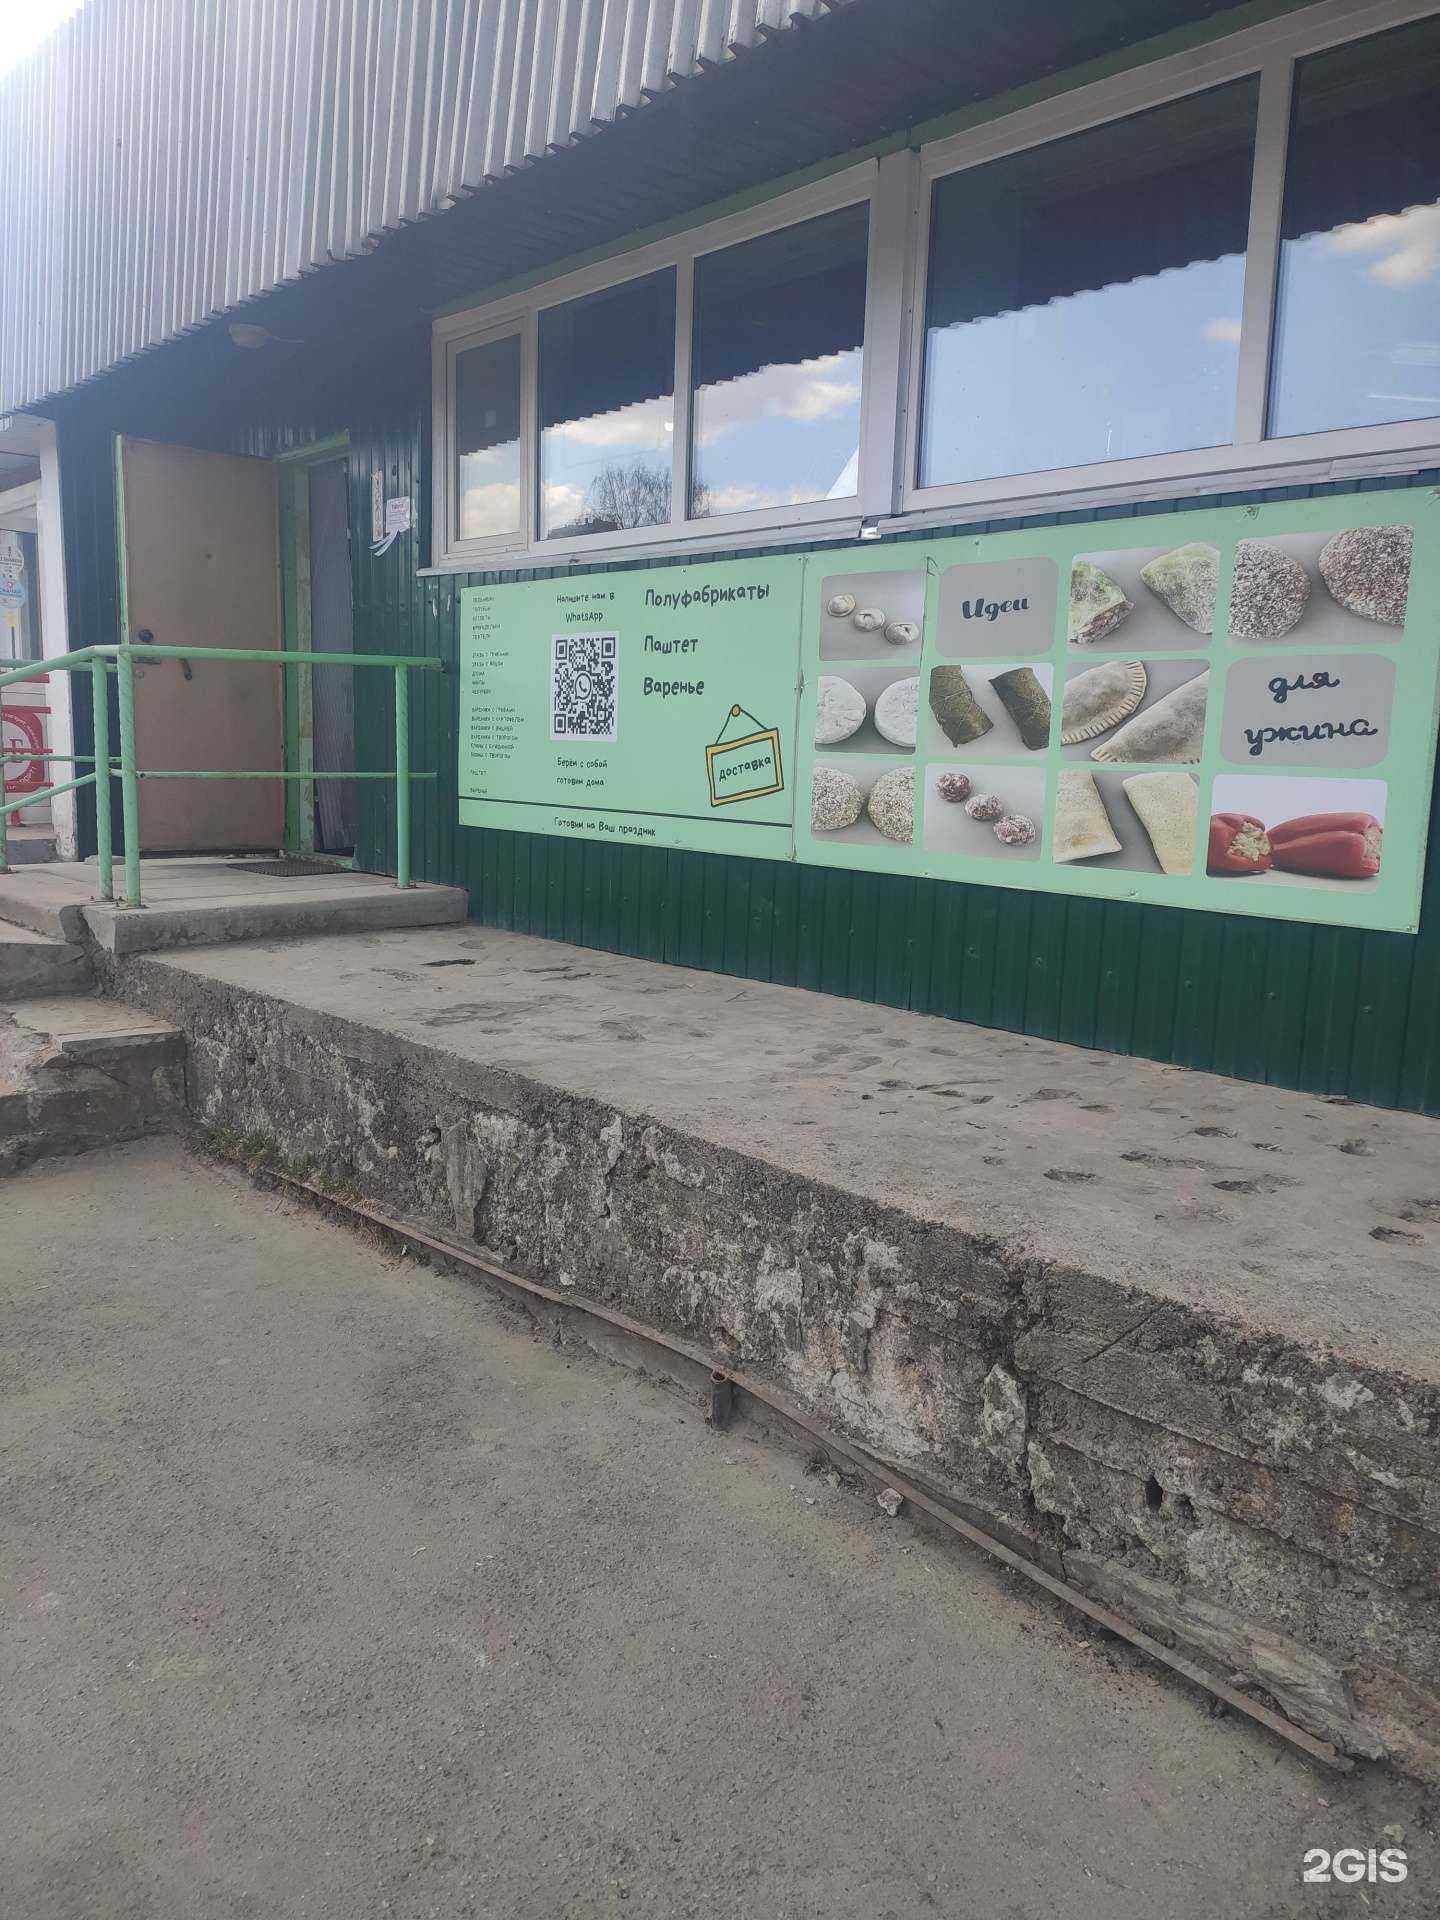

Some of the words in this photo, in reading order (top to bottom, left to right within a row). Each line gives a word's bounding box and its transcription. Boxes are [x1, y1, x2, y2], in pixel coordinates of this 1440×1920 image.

[556, 594, 589, 604] Напишите
[592, 593, 606, 601] нам
[644, 584, 770, 610] Полуфабрикаты
[565, 611, 604, 625] WhatsApp
[962, 597, 1030, 622] Идеи
[643, 635, 698, 655] Паштет
[643, 677, 705, 699] Варенье
[1268, 672, 1341, 704] для
[1244, 719, 1379, 757] ужина
[586, 759, 608, 769] собой
[718, 755, 772, 782] доставка
[556, 776, 584, 786] готовим
[586, 778, 605, 788] дома
[554, 816, 584, 829] Готовим
[587, 821, 596, 830] на
[598, 820, 616, 833] Ваш
[618, 823, 656, 838] праздник
